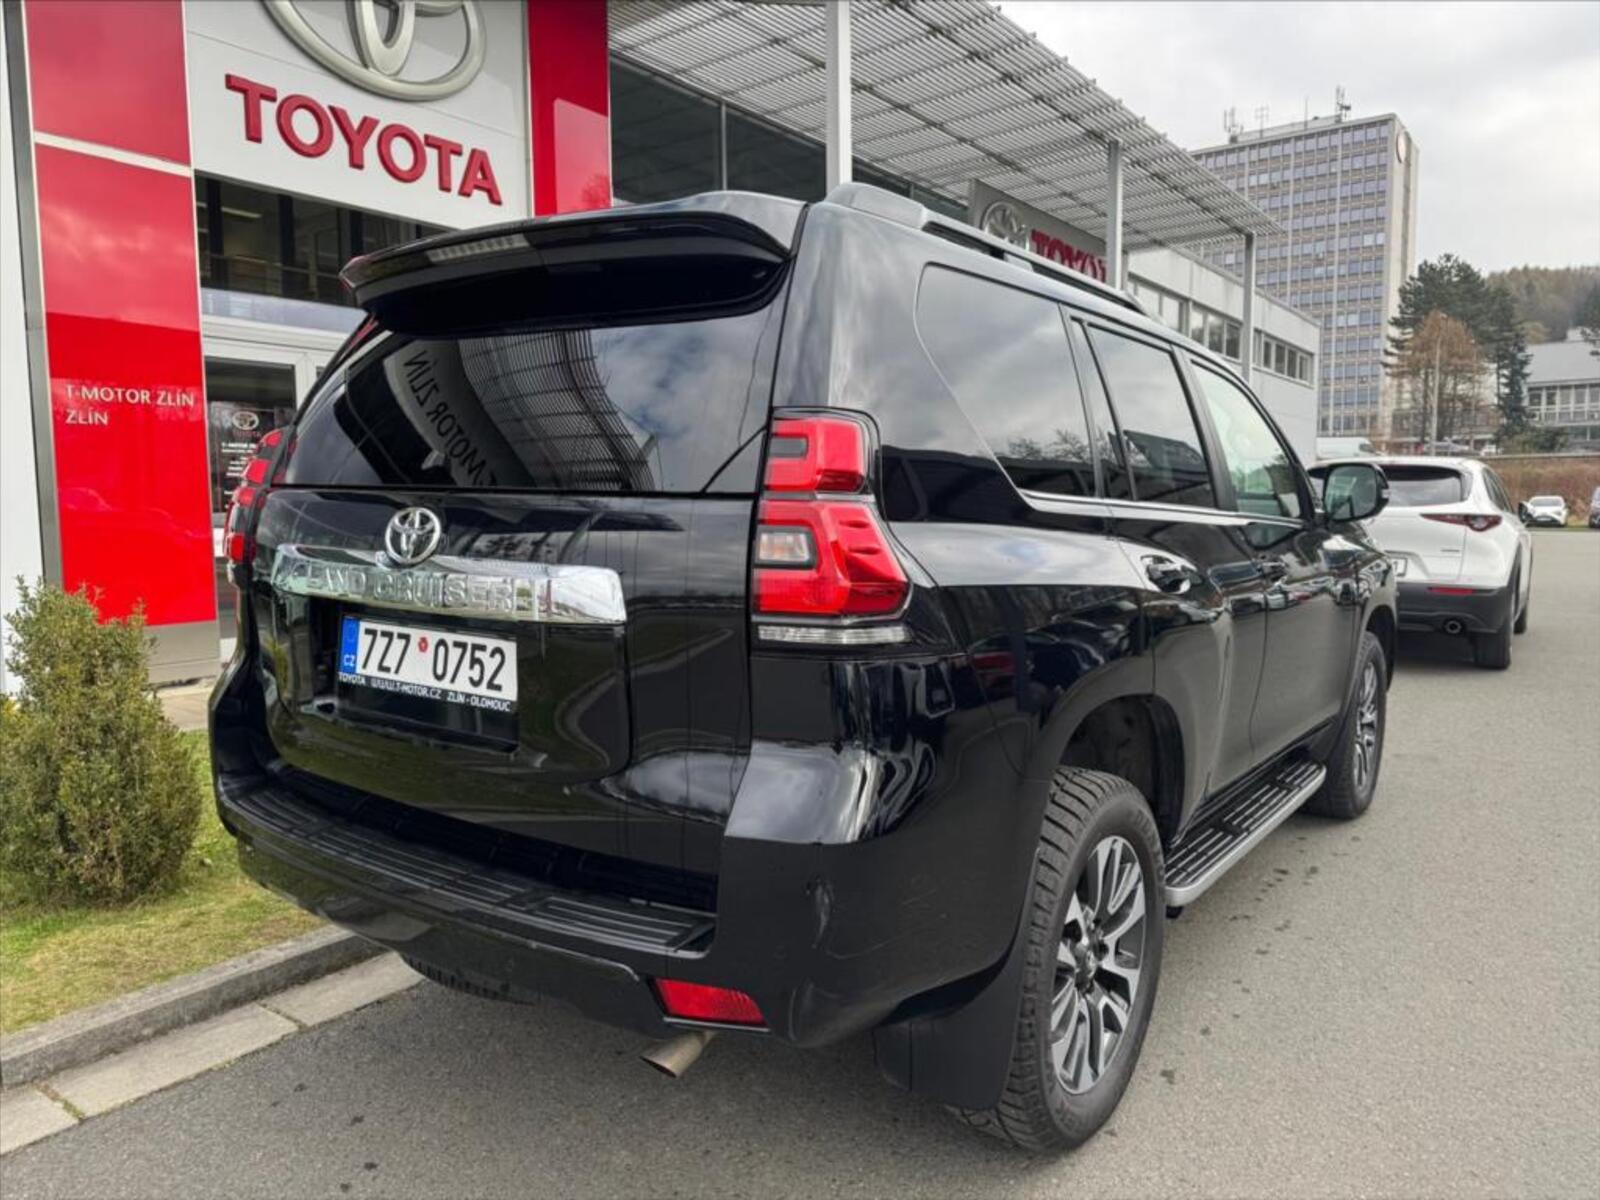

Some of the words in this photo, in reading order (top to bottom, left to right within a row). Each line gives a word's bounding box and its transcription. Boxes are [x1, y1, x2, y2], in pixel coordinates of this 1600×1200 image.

[225, 73, 502, 206] TOYOTA
[65, 384, 151, 404] T-MOTOR
[156, 388, 195, 408] ZLÍN
[65, 407, 108, 425] ZLÍN
[373, 570, 513, 612] CRUISER
[343, 655, 356, 667] CZ
[362, 628, 411, 674] 7Z7
[432, 638, 505, 692] 0752
[338, 671, 366, 686] TOYOTA
[470, 696, 512, 712] OLOMOUC
